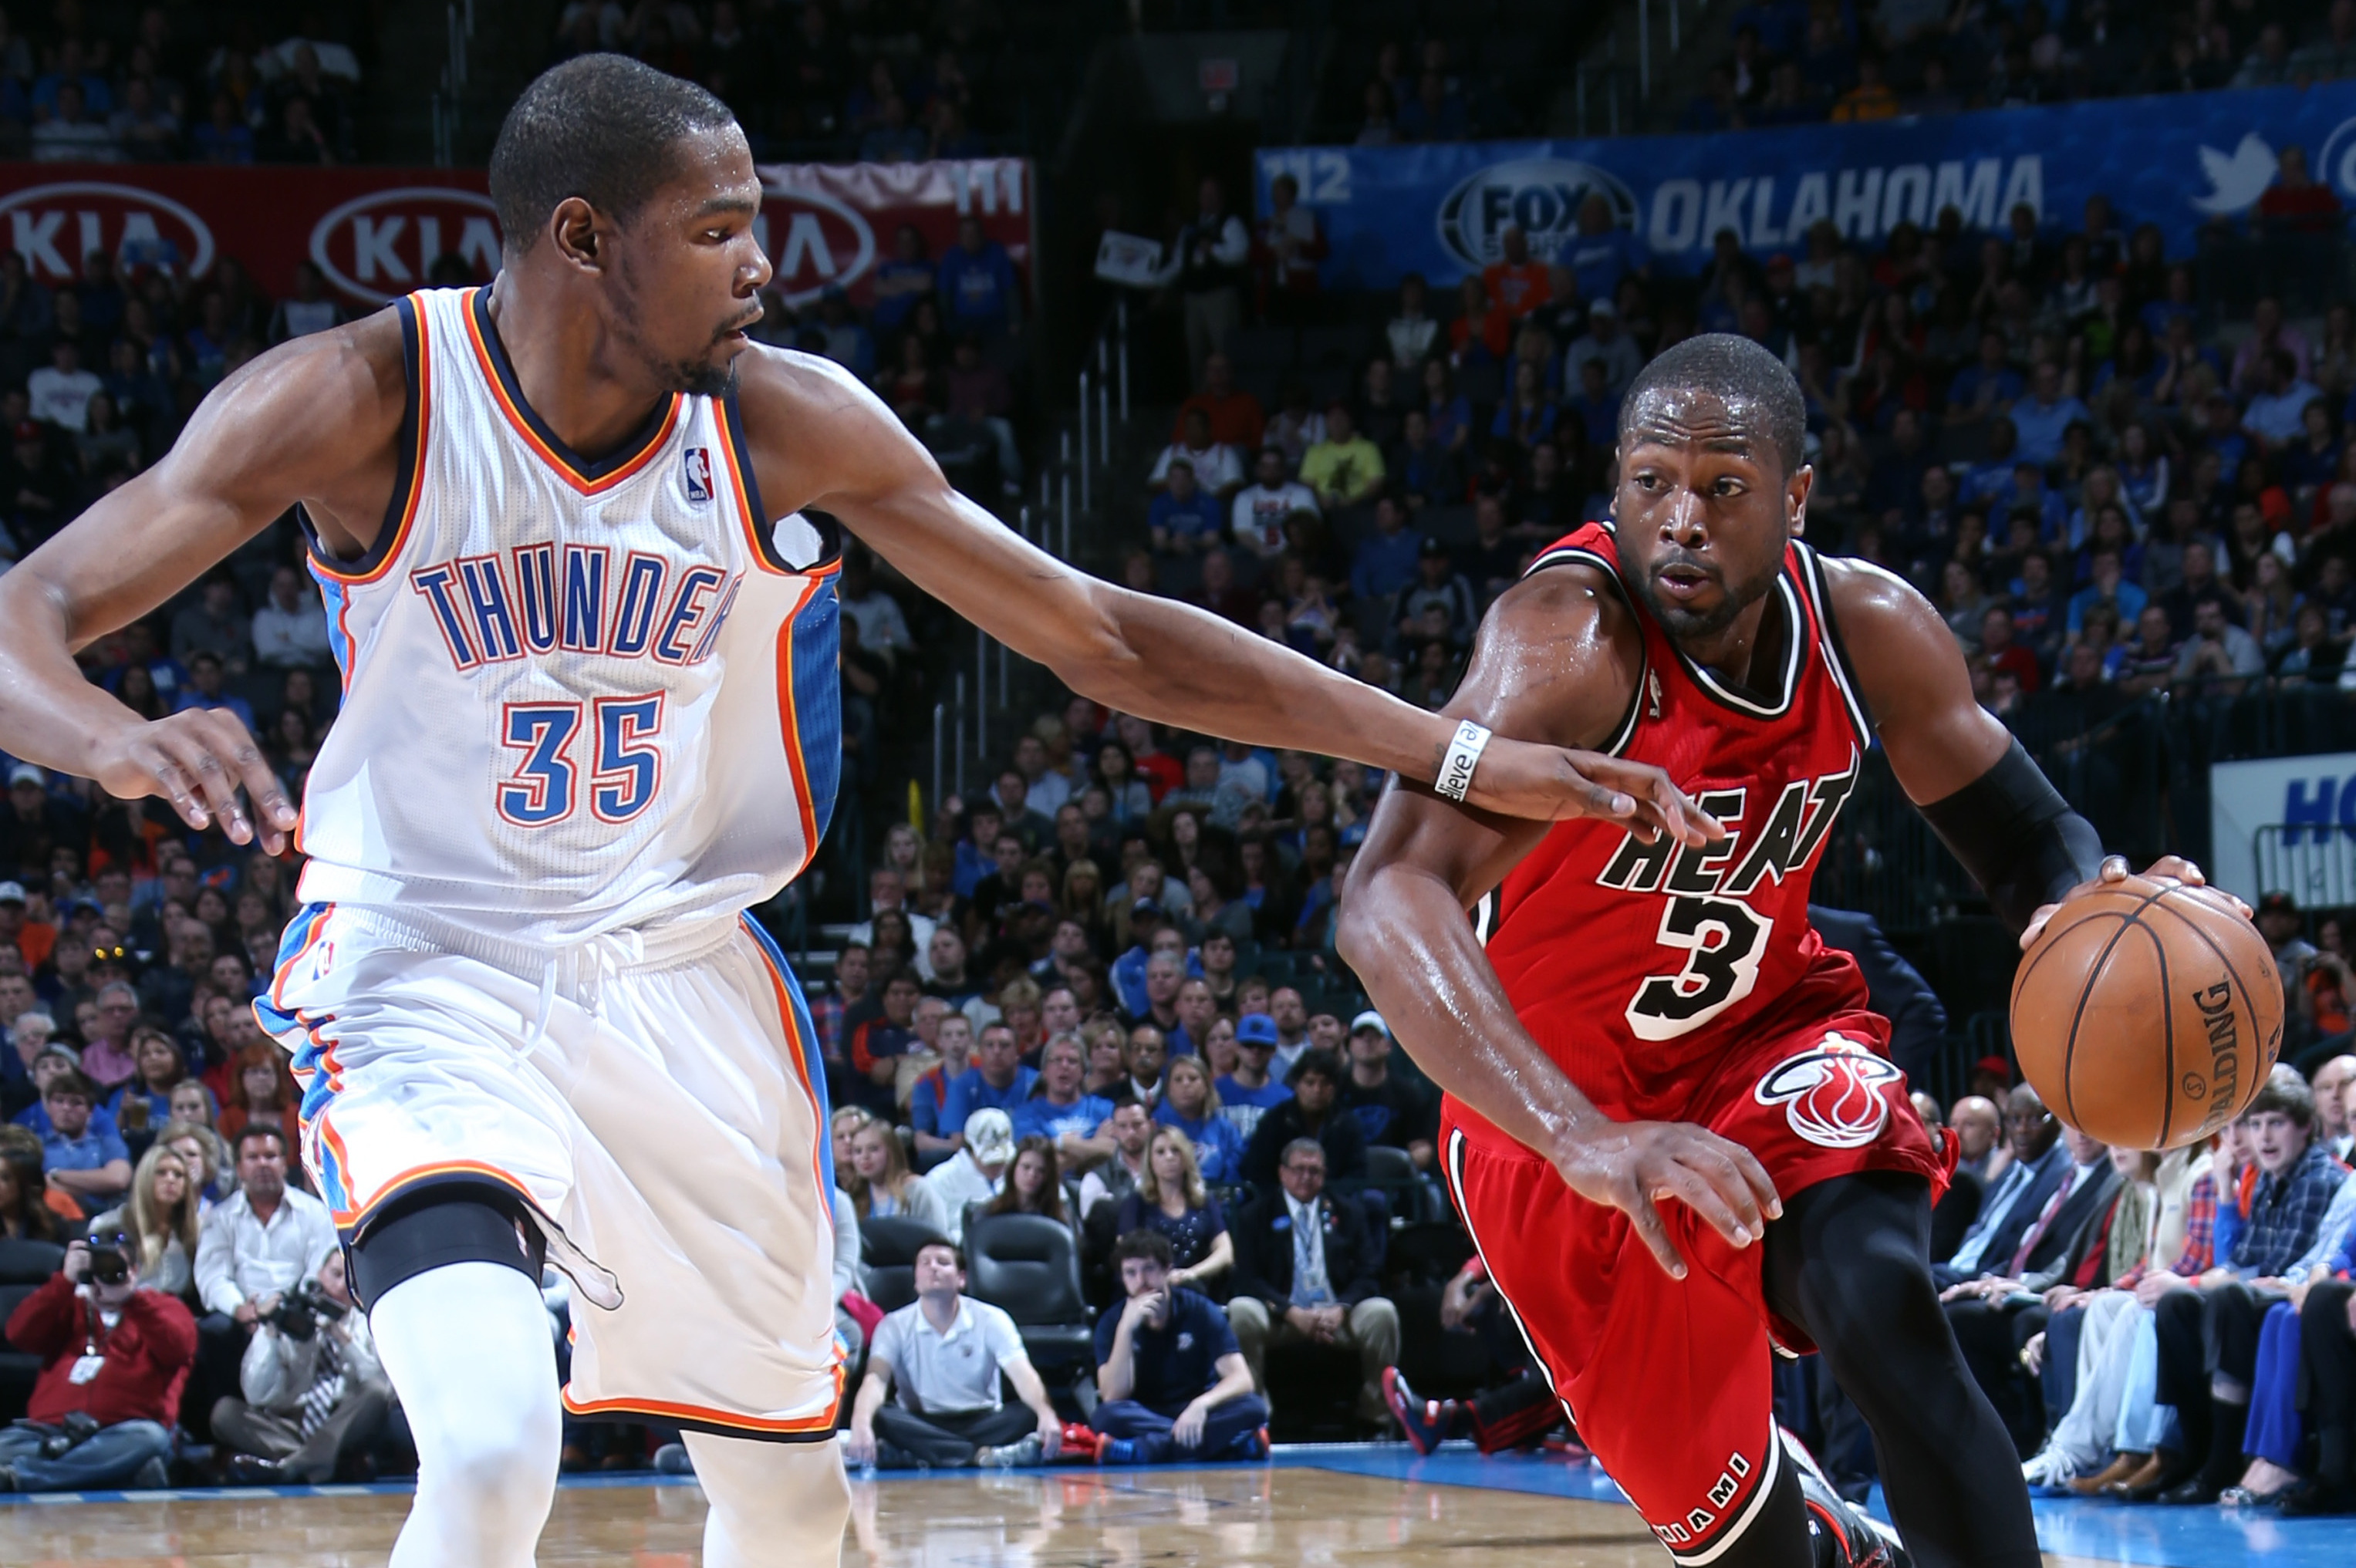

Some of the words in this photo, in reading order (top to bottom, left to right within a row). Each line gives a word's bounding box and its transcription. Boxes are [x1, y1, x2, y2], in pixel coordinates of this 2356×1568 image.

[9, 209, 179, 280] KIA
[352, 214, 503, 283] KIA
[1483, 186, 1591, 234] FOX
[1649, 155, 2044, 253] OKLAHOMA
[495, 690, 666, 828] 35
[1595, 741, 1861, 895] HEAT
[1624, 895, 1774, 1041] 3
[2192, 979, 2237, 1129] PALDING
[1652, 1451, 1750, 1543] MIAMI
